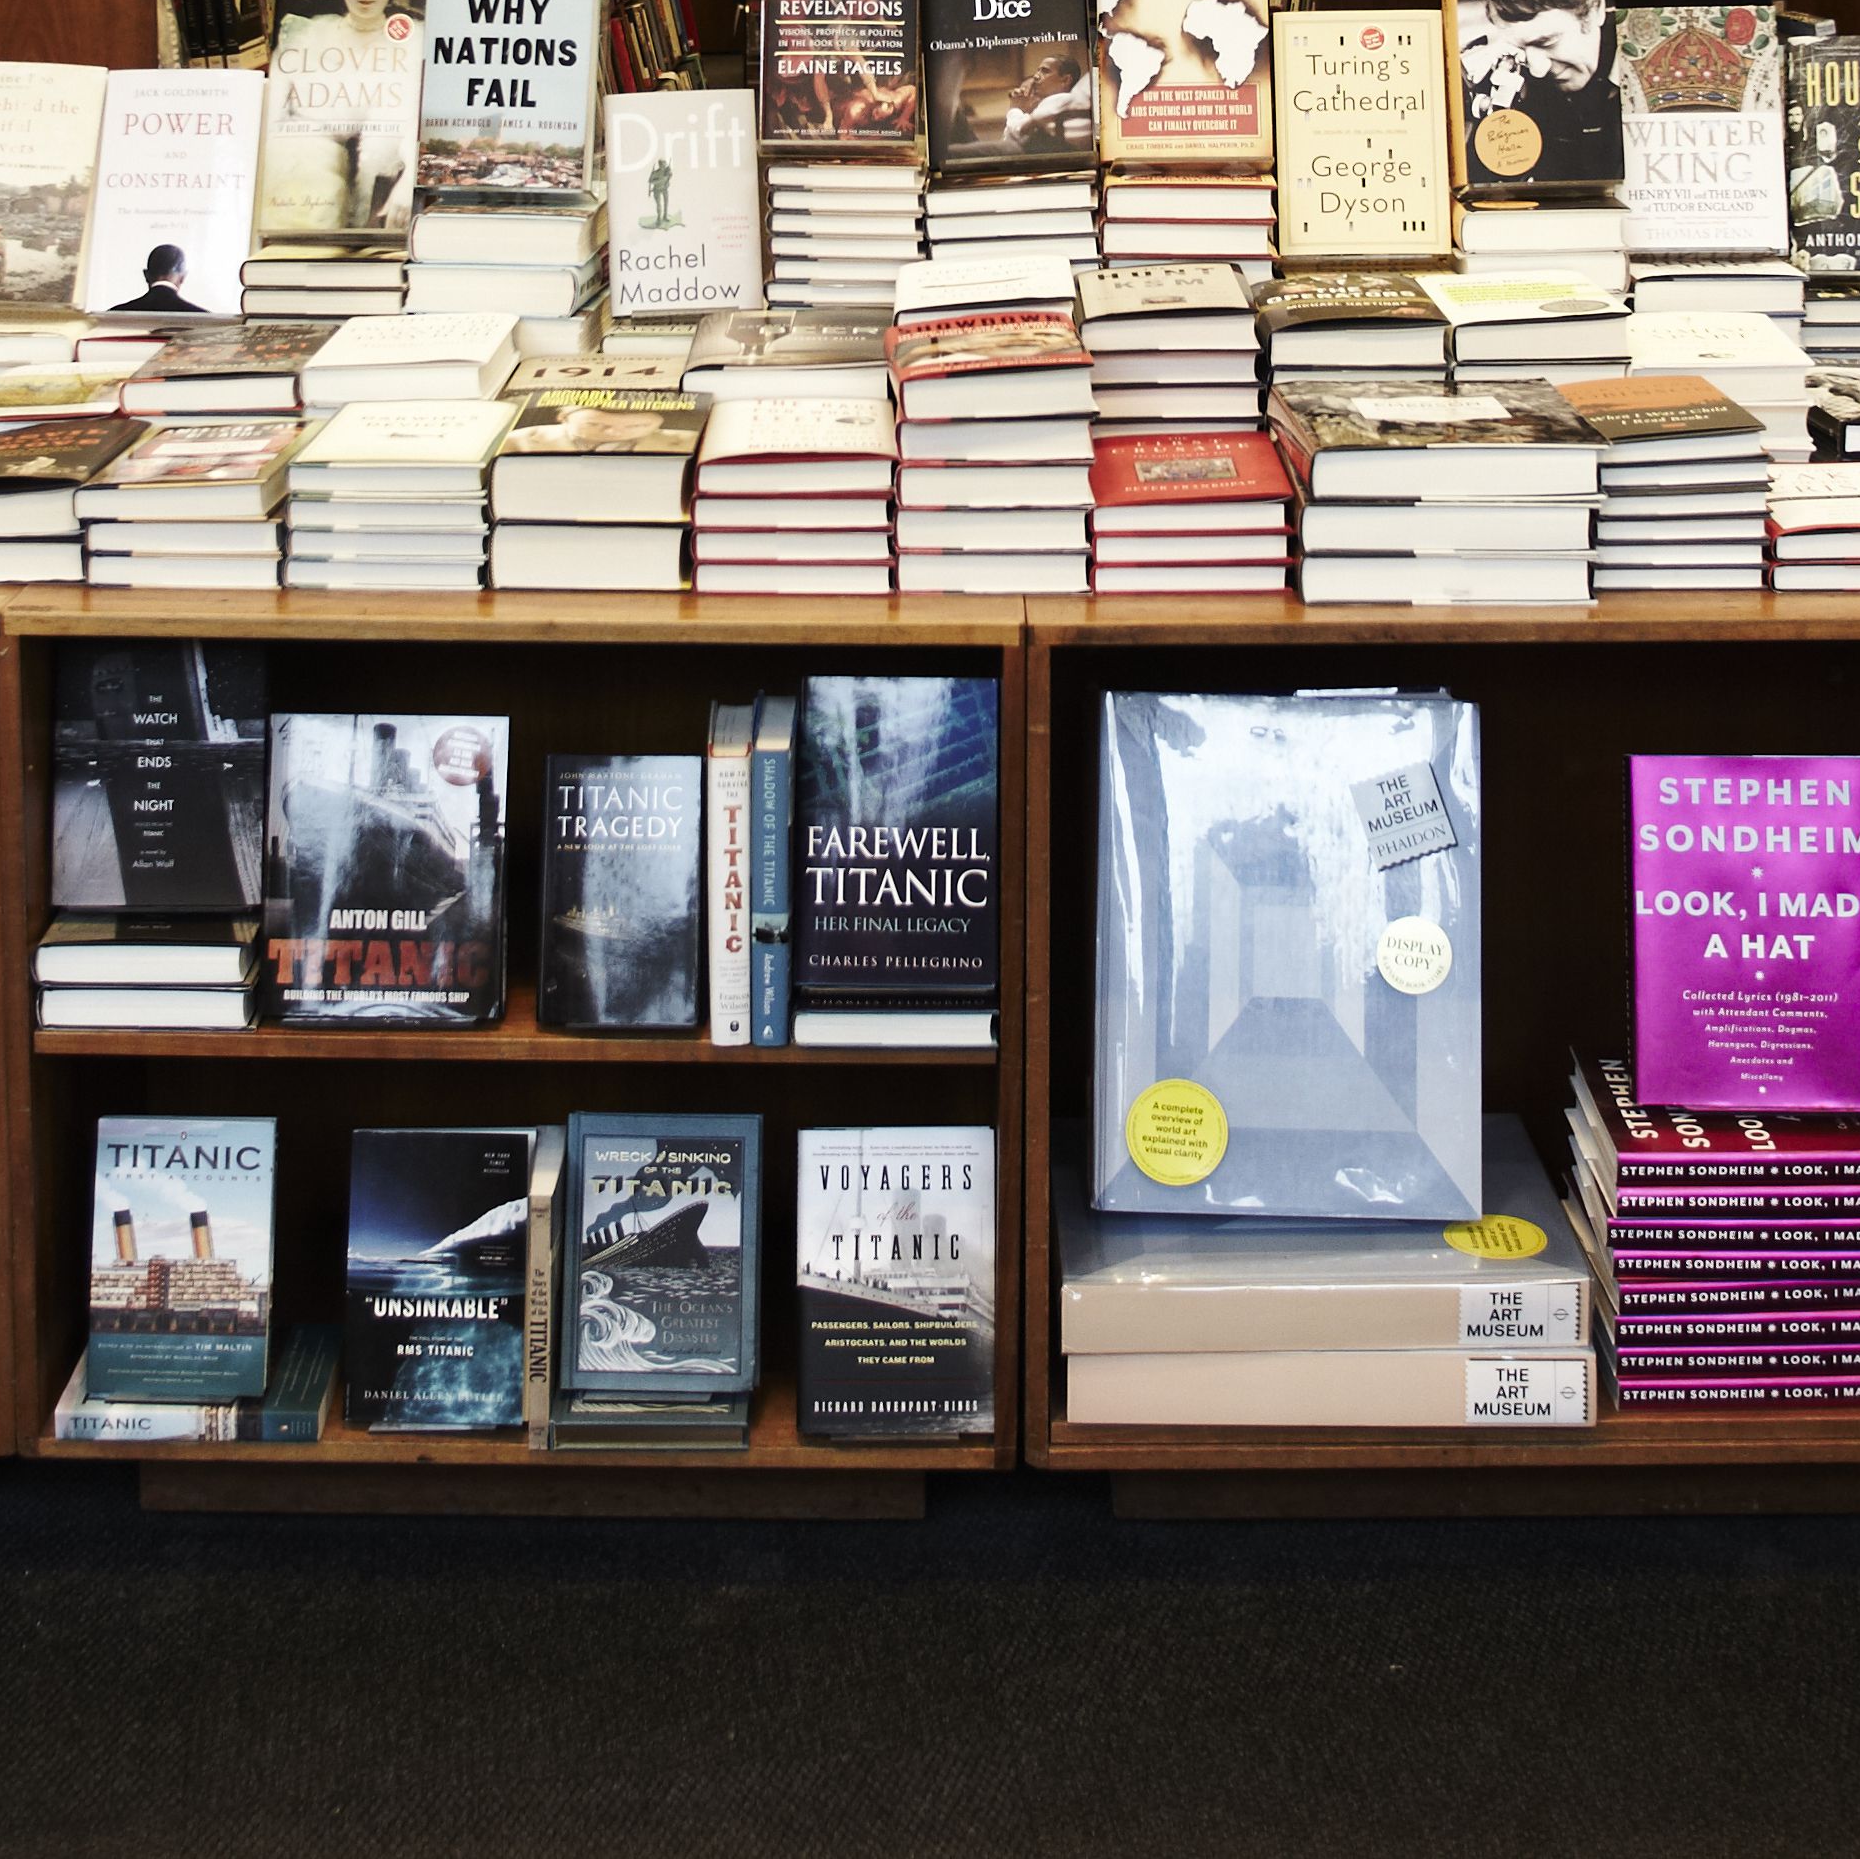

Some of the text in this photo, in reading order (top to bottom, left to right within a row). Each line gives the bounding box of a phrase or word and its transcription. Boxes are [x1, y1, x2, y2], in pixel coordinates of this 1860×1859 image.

[780, 0, 903, 17] REVELATIONS
[433, 38, 577, 67] NATIONS
[930, 30, 1079, 51] Obama's Diplomacy with Iran
[778, 59, 902, 76] ELAINE PAGELS
[1305, 52, 1410, 82] Turing's
[467, 78, 537, 108] FAIL
[1293, 89, 1425, 114] Cathedral
[1311, 154, 1412, 184] George
[1320, 190, 1405, 219] Dyson
[620, 244, 706, 271] Rachel
[620, 278, 740, 304] Maddow
[133, 713, 178, 725] WATCH
[137, 756, 173, 768] ENDS
[134, 799, 175, 812] NIGHT
[1658, 778, 1851, 808] STEPHEN
[806, 826, 989, 864] FAREWELL,
[807, 865, 988, 908] TITANIC
[1636, 890, 1746, 922] LOOK,
[1756, 890, 1766, 918] I
[815, 916, 971, 936] HER FINAL LEGACY
[1387, 937, 1442, 956] DISPLAY
[1704, 934, 1815, 960] A HAT
[1394, 955, 1430, 970] COPY
[1682, 990, 1734, 1001] Collected
[1738, 991, 1772, 1003] Lyrics
[106, 1142, 260, 1171] TITANIC
[819, 1162, 973, 1191] VOYAGERS
[832, 1232, 961, 1260] TITANIC
[365, 1294, 508, 1322] "UNSINKABLE"
[1489, 1292, 1523, 1308] THE
[1489, 1308, 1522, 1322] ART
[1467, 1322, 1544, 1339] MUSEUM
[397, 1344, 474, 1358] RMS TITANIC
